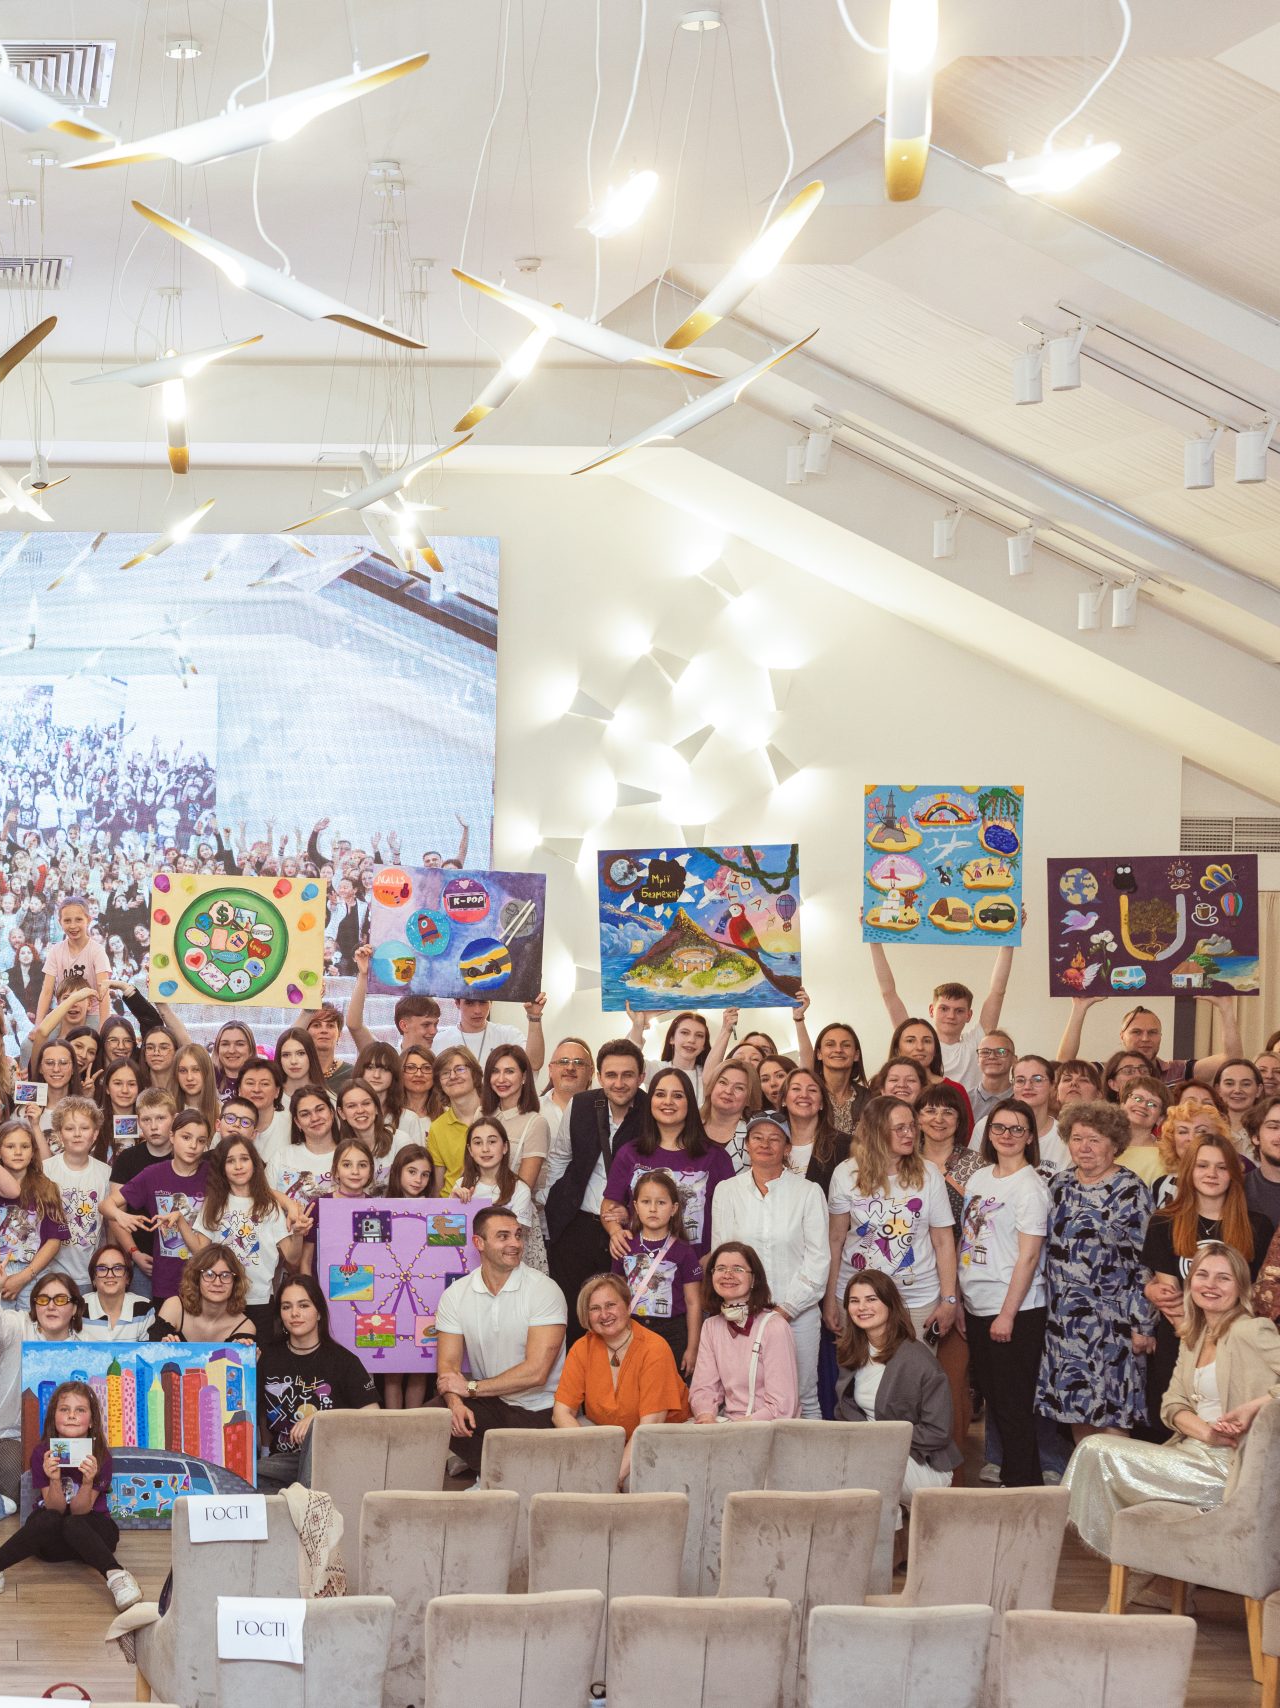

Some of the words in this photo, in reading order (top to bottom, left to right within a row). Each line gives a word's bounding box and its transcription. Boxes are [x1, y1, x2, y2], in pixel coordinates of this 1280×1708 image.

[453, 896, 484, 906] K-POP
[205, 1505, 249, 1521] ГОСТІ
[236, 1620, 285, 1637] ГОСТІ
